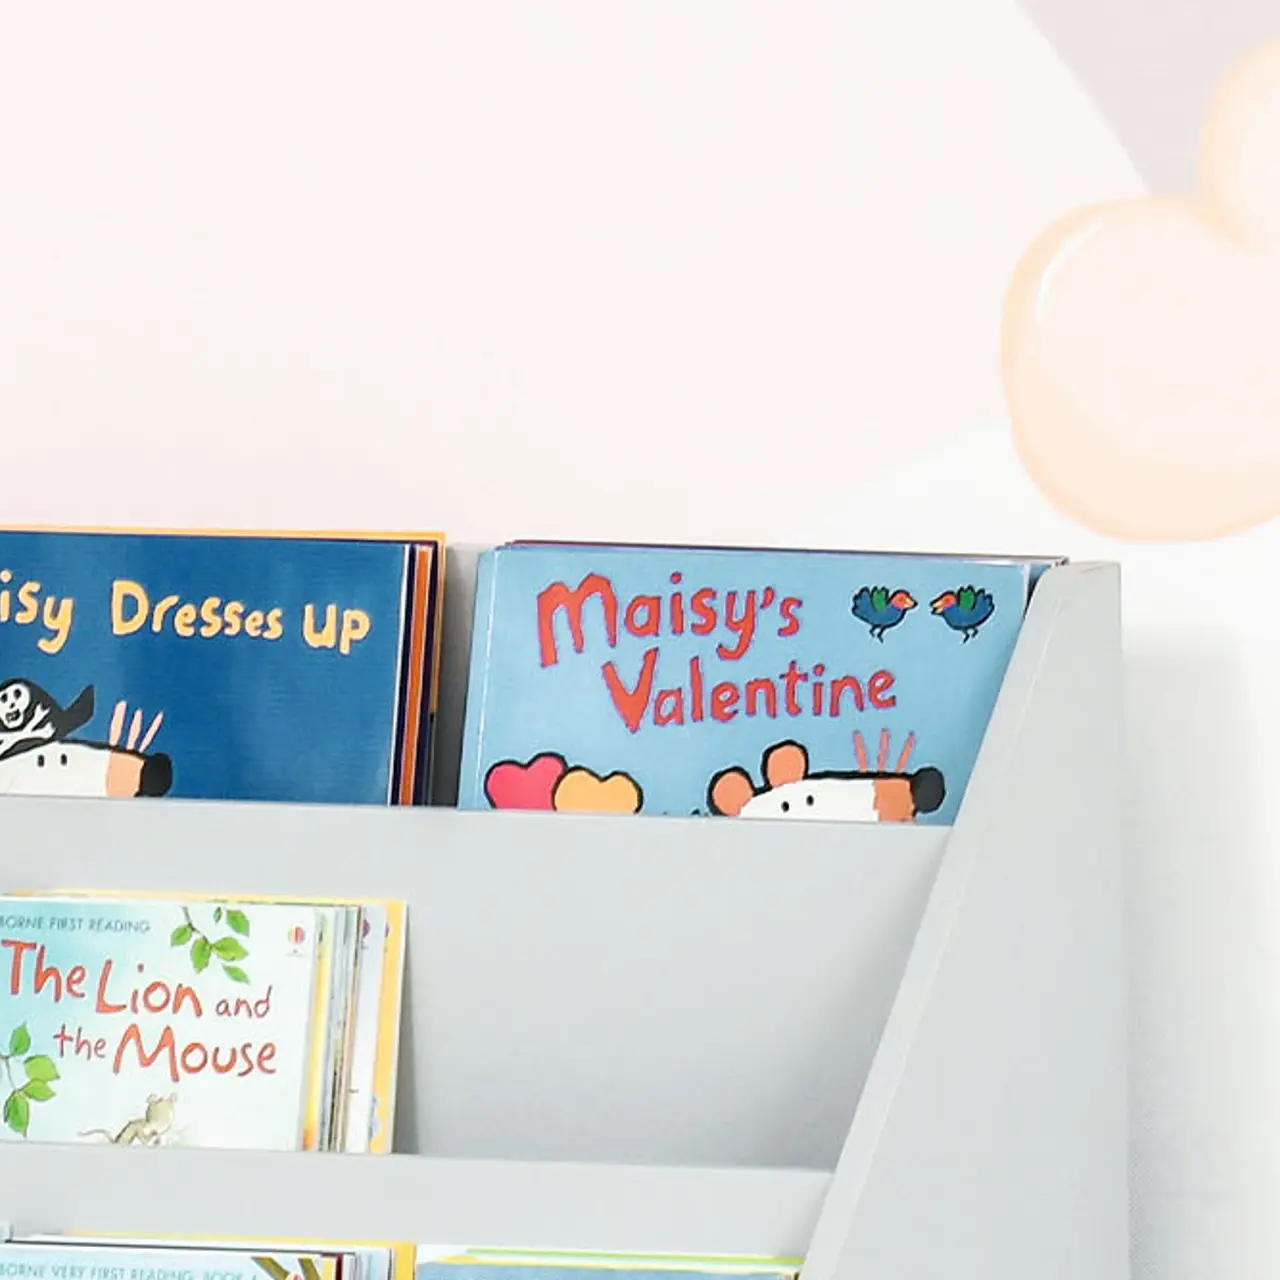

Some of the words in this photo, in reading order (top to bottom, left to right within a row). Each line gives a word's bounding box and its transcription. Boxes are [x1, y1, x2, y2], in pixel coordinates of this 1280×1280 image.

[110, 579, 285, 639] Dresses
[535, 571, 804, 668] Maisy's
[600, 647, 898, 734] Valentine
[49, 916, 83, 931] FIRST
[88, 917, 151, 933] READING
[0, 938, 87, 1002] The
[95, 959, 203, 1018] Lion
[215, 985, 273, 1018] and
[53, 1022, 107, 1061] the
[113, 1022, 277, 1083] Mouse
[51, 1265, 85, 1280] VERY
[90, 1267, 125, 1280] FIRST
